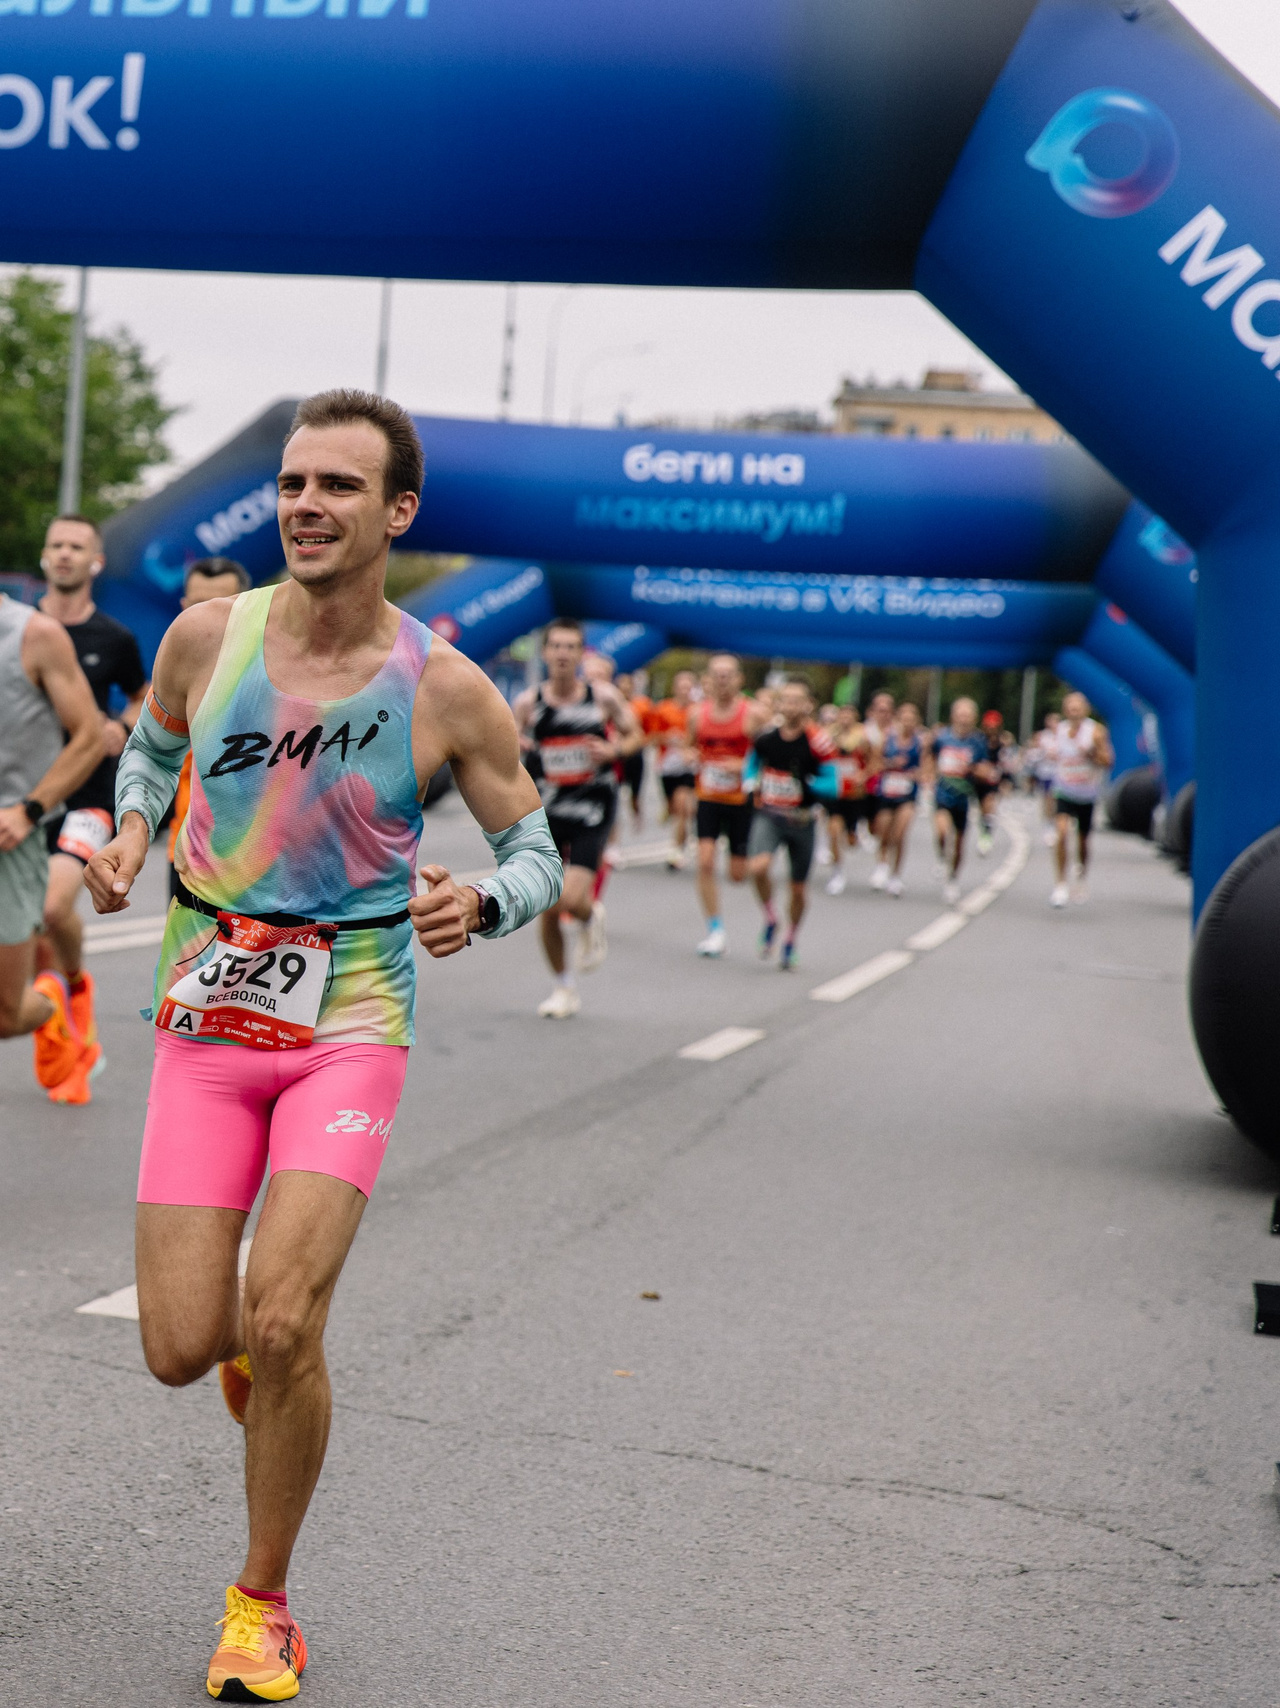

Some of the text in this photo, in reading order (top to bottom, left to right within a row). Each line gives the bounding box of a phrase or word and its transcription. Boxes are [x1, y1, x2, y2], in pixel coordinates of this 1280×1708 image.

[622, 442, 805, 485] беги на
[575, 492, 848, 543] максимум!
[202, 721, 379, 780] BMAI
[294, 933, 322, 948] KM
[206, 990, 277, 1013] ВСЕВОЛОД
[174, 1012, 194, 1031] A
[325, 1110, 393, 1144] BM
